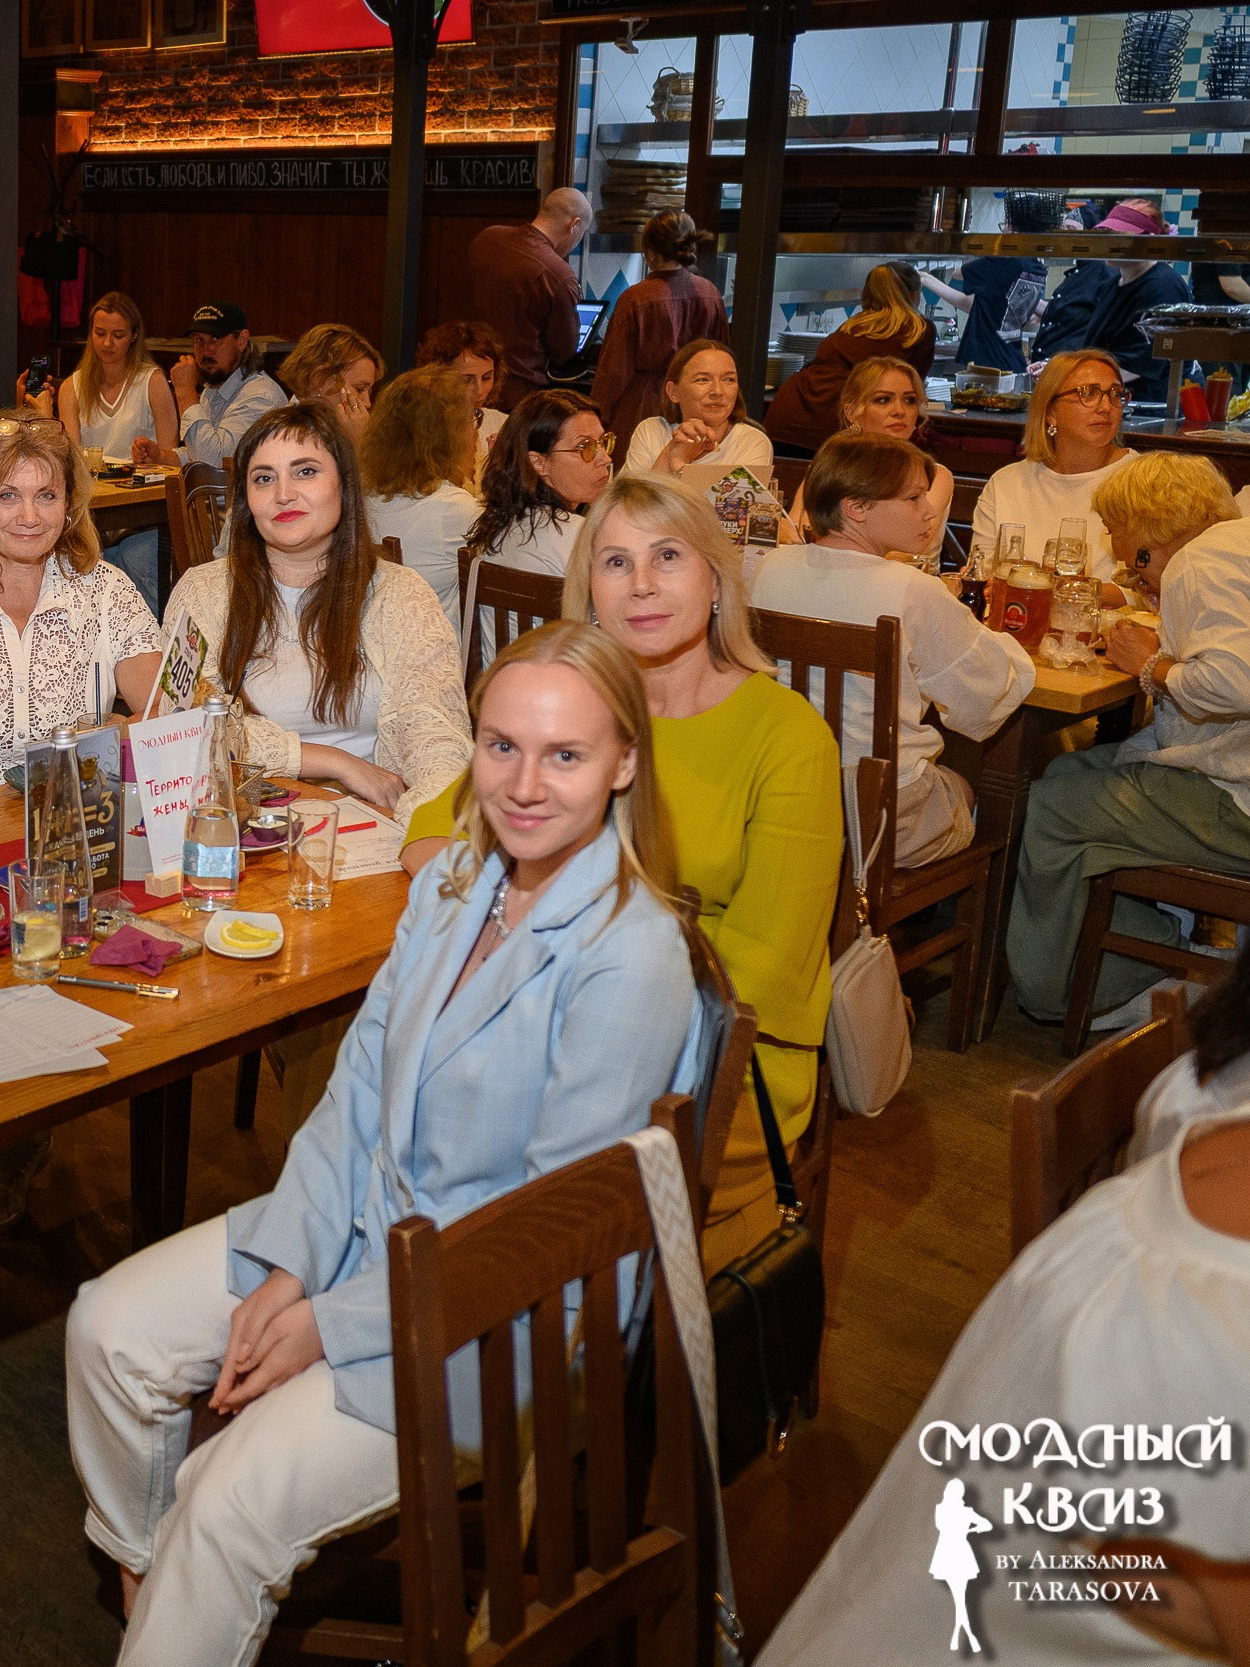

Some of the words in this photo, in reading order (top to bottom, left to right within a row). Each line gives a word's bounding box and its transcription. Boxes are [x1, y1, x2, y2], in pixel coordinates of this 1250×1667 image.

[270, 160, 332, 186] ЗНАЧИТ
[342, 161, 366, 186] ТЫ
[460, 158, 535, 186] КРАСИВ
[170, 655, 194, 698] 405
[137, 729, 182, 751] МОДНЫЙ
